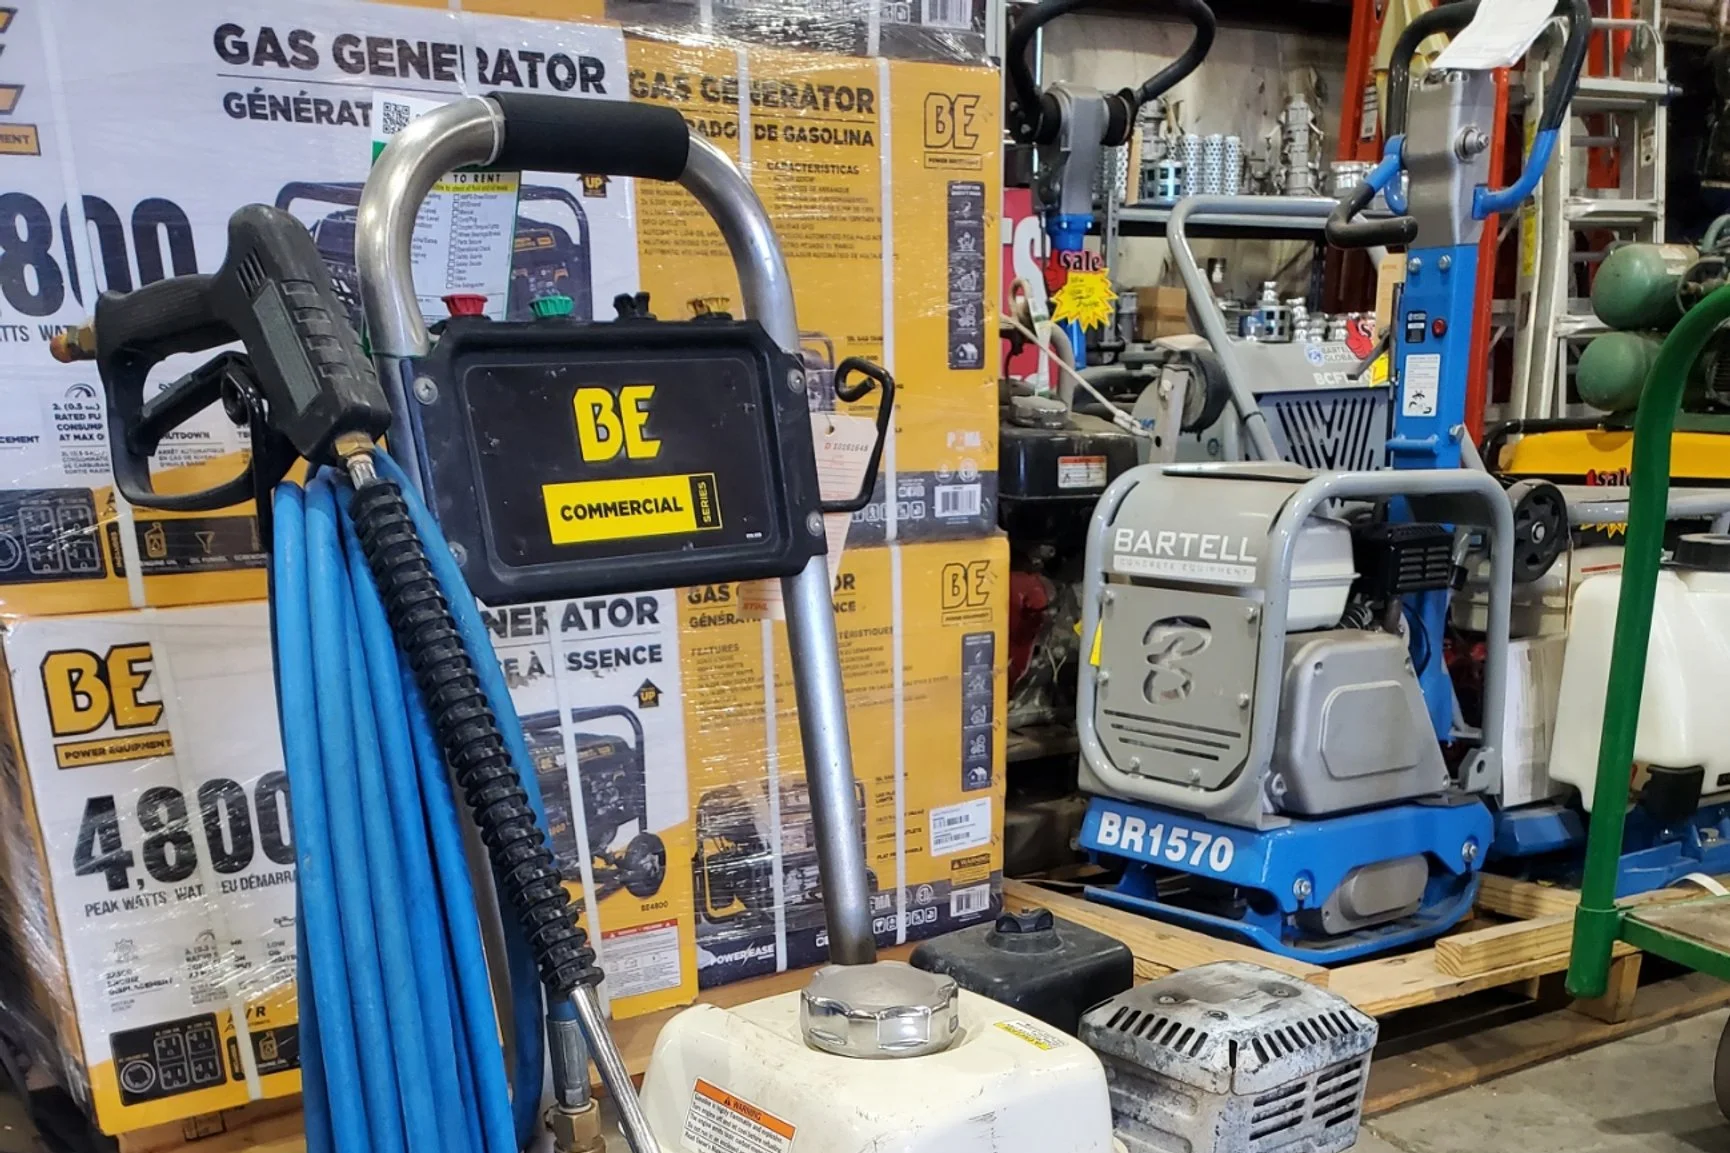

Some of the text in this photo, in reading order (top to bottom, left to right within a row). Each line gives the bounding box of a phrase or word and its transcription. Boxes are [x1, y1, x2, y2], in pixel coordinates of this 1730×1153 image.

[213, 22, 607, 94] GAS GENERATOR
[629, 71, 692, 99] GAS
[223, 87, 371, 127] GÉNÉRAT
[924, 92, 981, 149] BE
[754, 124, 779, 141] DE
[784, 125, 875, 147] GASOLINA
[454, 173, 501, 183] TO RENT
[585, 176, 603, 189] UP
[1061, 250, 1101, 272] sale
[39, 325, 71, 342] WAT
[57, 423, 103, 432] CONSUMP
[164, 431, 211, 440] UTDOWN
[573, 385, 662, 463] BE
[1596, 468, 1632, 487] sal
[560, 481, 711, 524] COMMERCIAL SERIES
[1114, 528, 1257, 563] BARTELL
[688, 584, 730, 605] GAS
[942, 560, 990, 610] BE
[481, 596, 660, 638] NERATOR
[839, 625, 894, 640] TÉRISTIQUE
[565, 644, 663, 671] SSENCE
[40, 642, 163, 738] BE
[65, 747, 106, 760] POWER
[74, 771, 296, 892] 4,800
[1097, 811, 1234, 873] BR1570
[85, 902, 119, 918] PEAK
[175, 883, 204, 901] WAT
